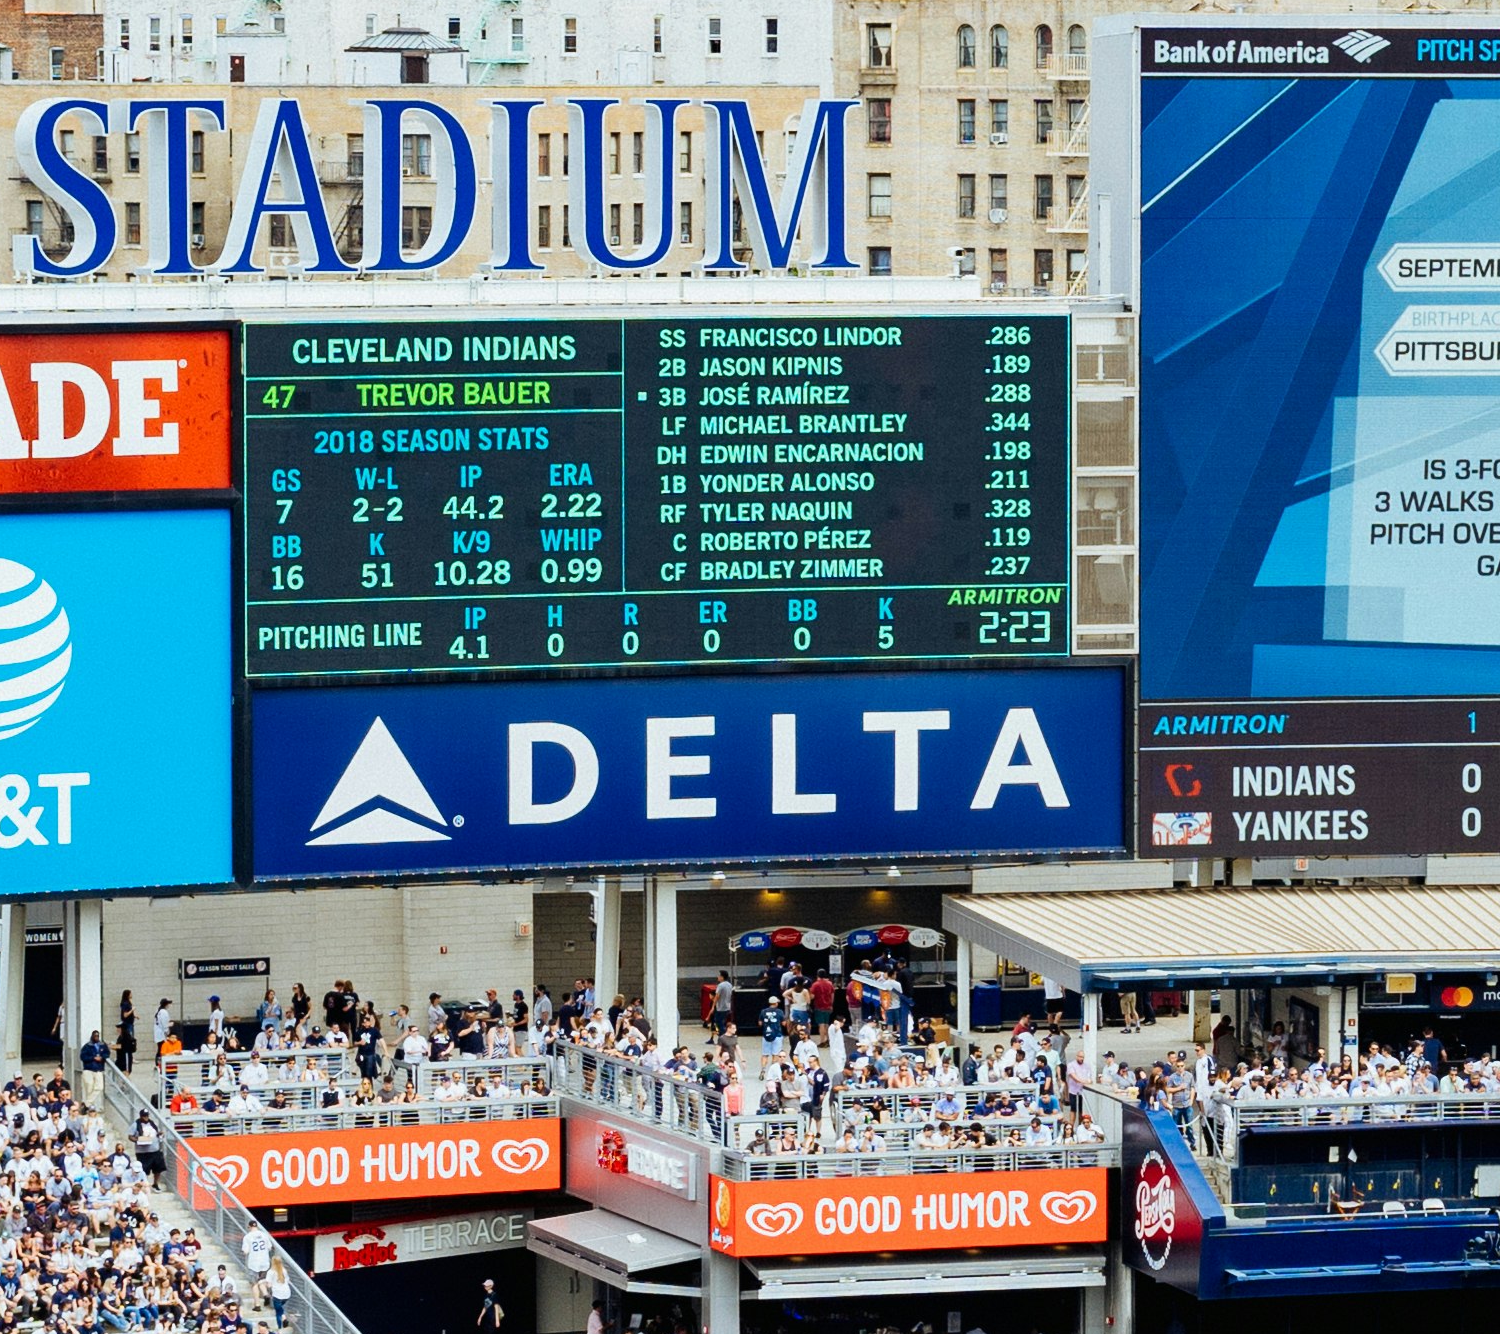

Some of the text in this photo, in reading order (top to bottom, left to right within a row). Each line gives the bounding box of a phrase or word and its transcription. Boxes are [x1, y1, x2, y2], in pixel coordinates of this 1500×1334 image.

[1417, 39, 1473, 62] PITCH
[14, 96, 861, 278] STADIUM
[292, 336, 576, 364] CLEVELAND INDIANS
[659, 326, 1031, 348] SS FRANCISCO LINDOR .286
[262, 381, 551, 408] 47 TREVOR BAUER
[947, 588, 1061, 605] ARMITRON
[258, 623, 422, 650] PITCHING LINE
[979, 611, 1051, 643] 2:23
[508, 707, 1070, 825] DELTA
[1232, 764, 1356, 797] INDIANS
[1232, 809, 1369, 841] YANKEES
[260, 1139, 482, 1190] GOOD HUMOR
[403, 1215, 524, 1253] TERRACE
